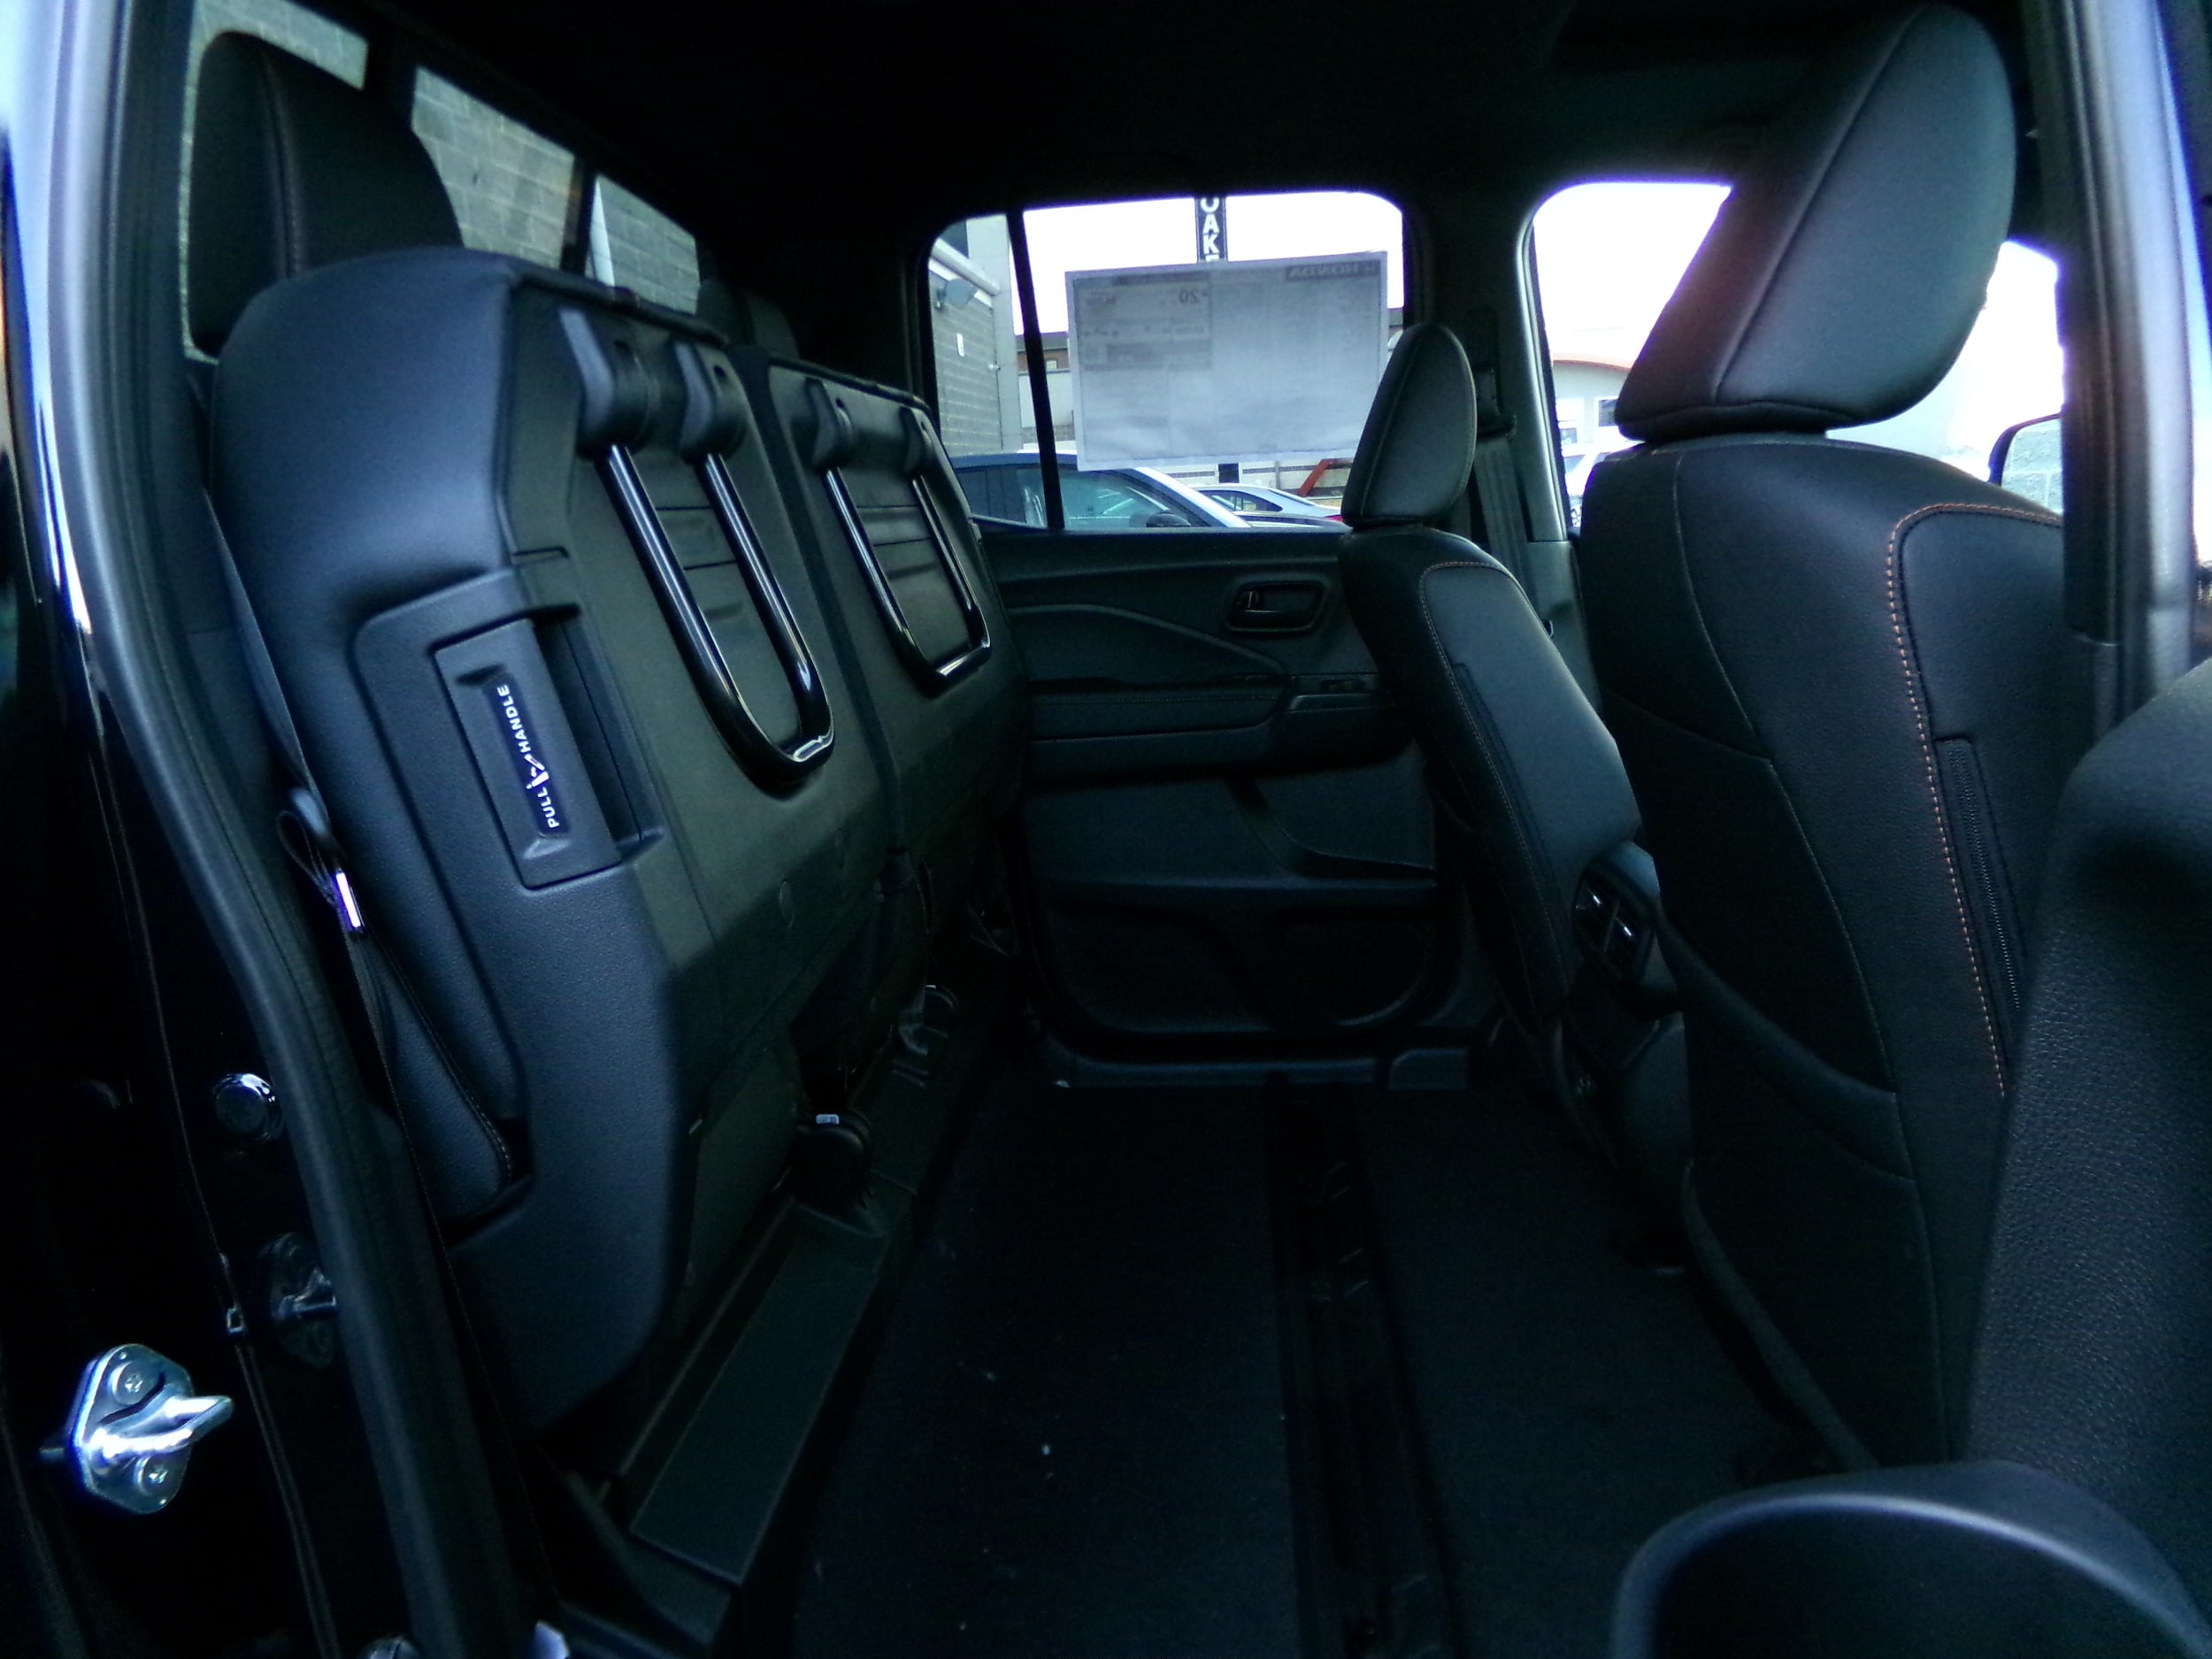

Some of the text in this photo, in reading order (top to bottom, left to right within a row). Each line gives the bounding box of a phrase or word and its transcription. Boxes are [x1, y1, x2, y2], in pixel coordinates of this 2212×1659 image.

[1200, 197, 1220, 262] OAK
[497, 685, 559, 828] PULL HANDLE
